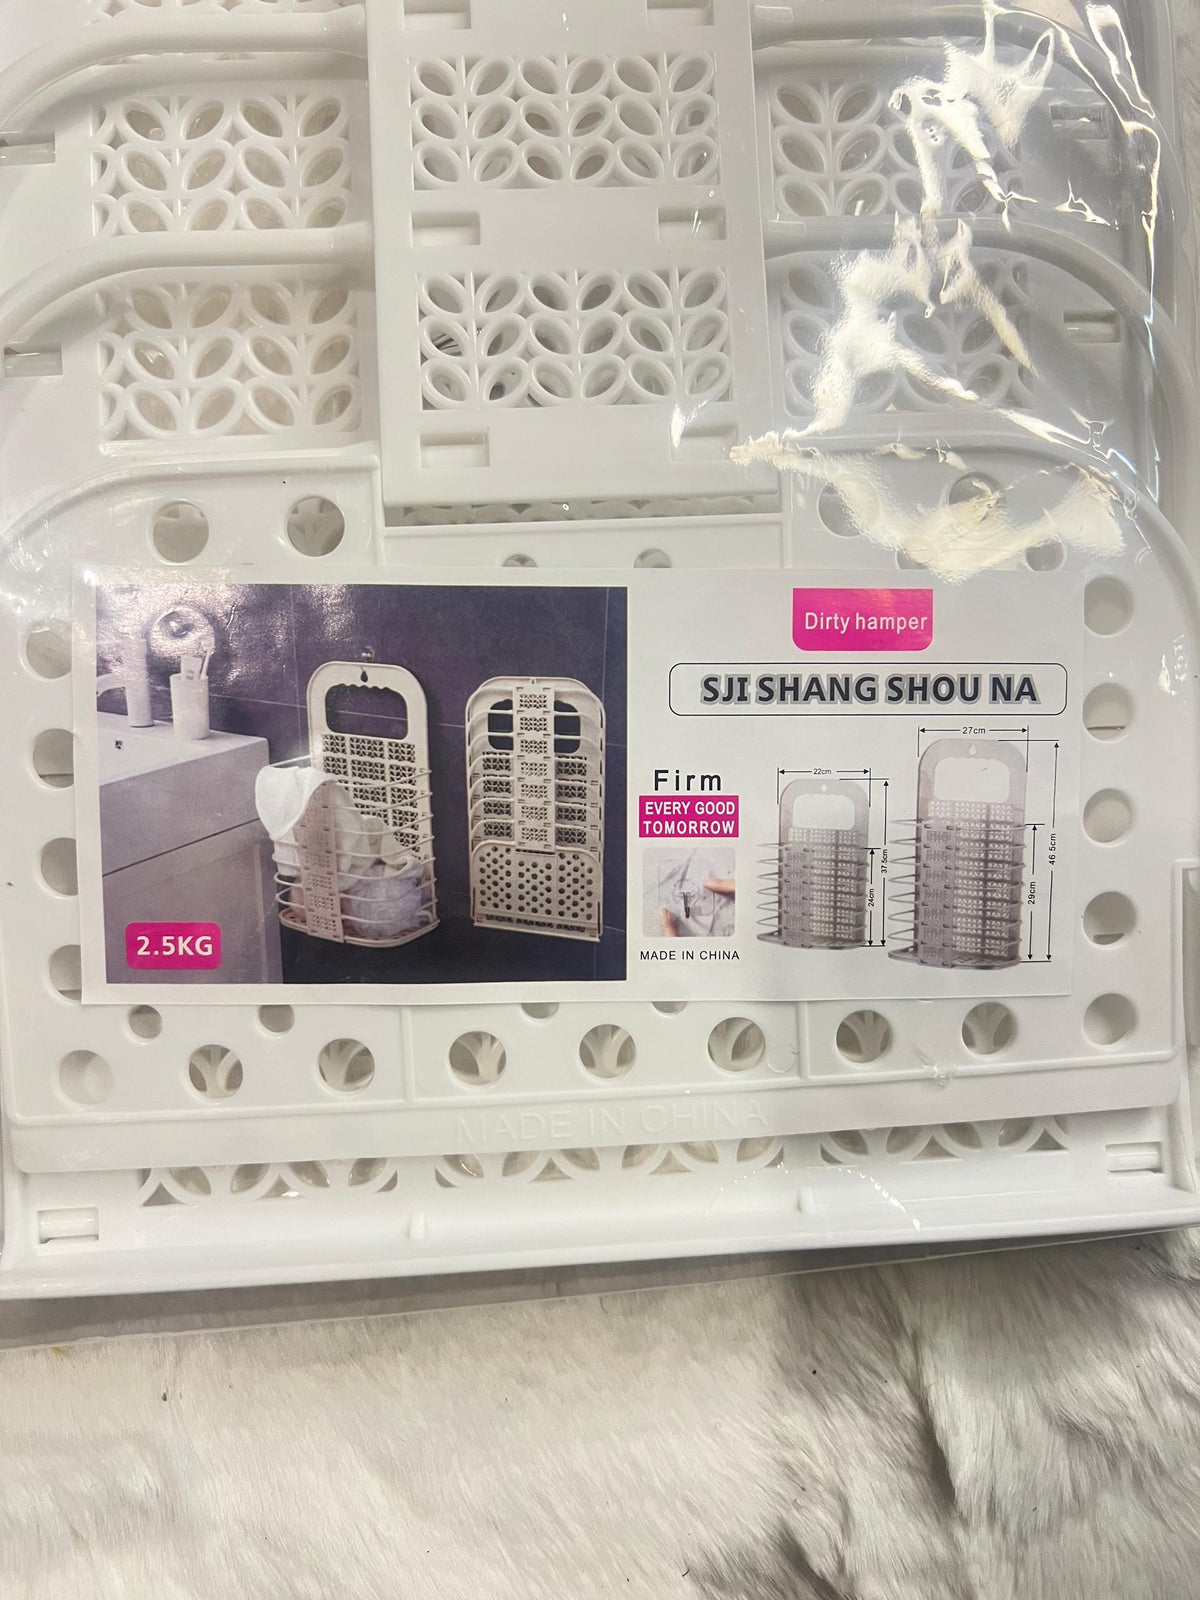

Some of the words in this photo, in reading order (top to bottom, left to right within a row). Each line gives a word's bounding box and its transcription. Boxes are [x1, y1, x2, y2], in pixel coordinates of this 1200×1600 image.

[804, 611, 850, 633] Dirty
[855, 611, 928, 633] hamper
[755, 673, 879, 705] SHANG
[884, 673, 982, 705] SHOU
[988, 674, 1041, 705] NA
[962, 725, 986, 735] 27cm
[653, 769, 723, 792] Firm
[813, 767, 832, 776] 22cm
[644, 800, 691, 815] EVERY
[694, 800, 736, 815] GOOD
[642, 819, 736, 834] TOMORROW
[1047, 832, 1057, 866] 46.5cm
[867, 887, 876, 907] 24cm
[1027, 880, 1037, 905] 29cm
[136, 936, 213, 956] 2.5KG
[639, 950, 677, 961] MADE
[681, 950, 696, 960] IN
[699, 949, 741, 960] CHINA
[455, 1110, 575, 1145] MADE
[589, 1105, 625, 1135] IN
[639, 1099, 769, 1133] CHINA
